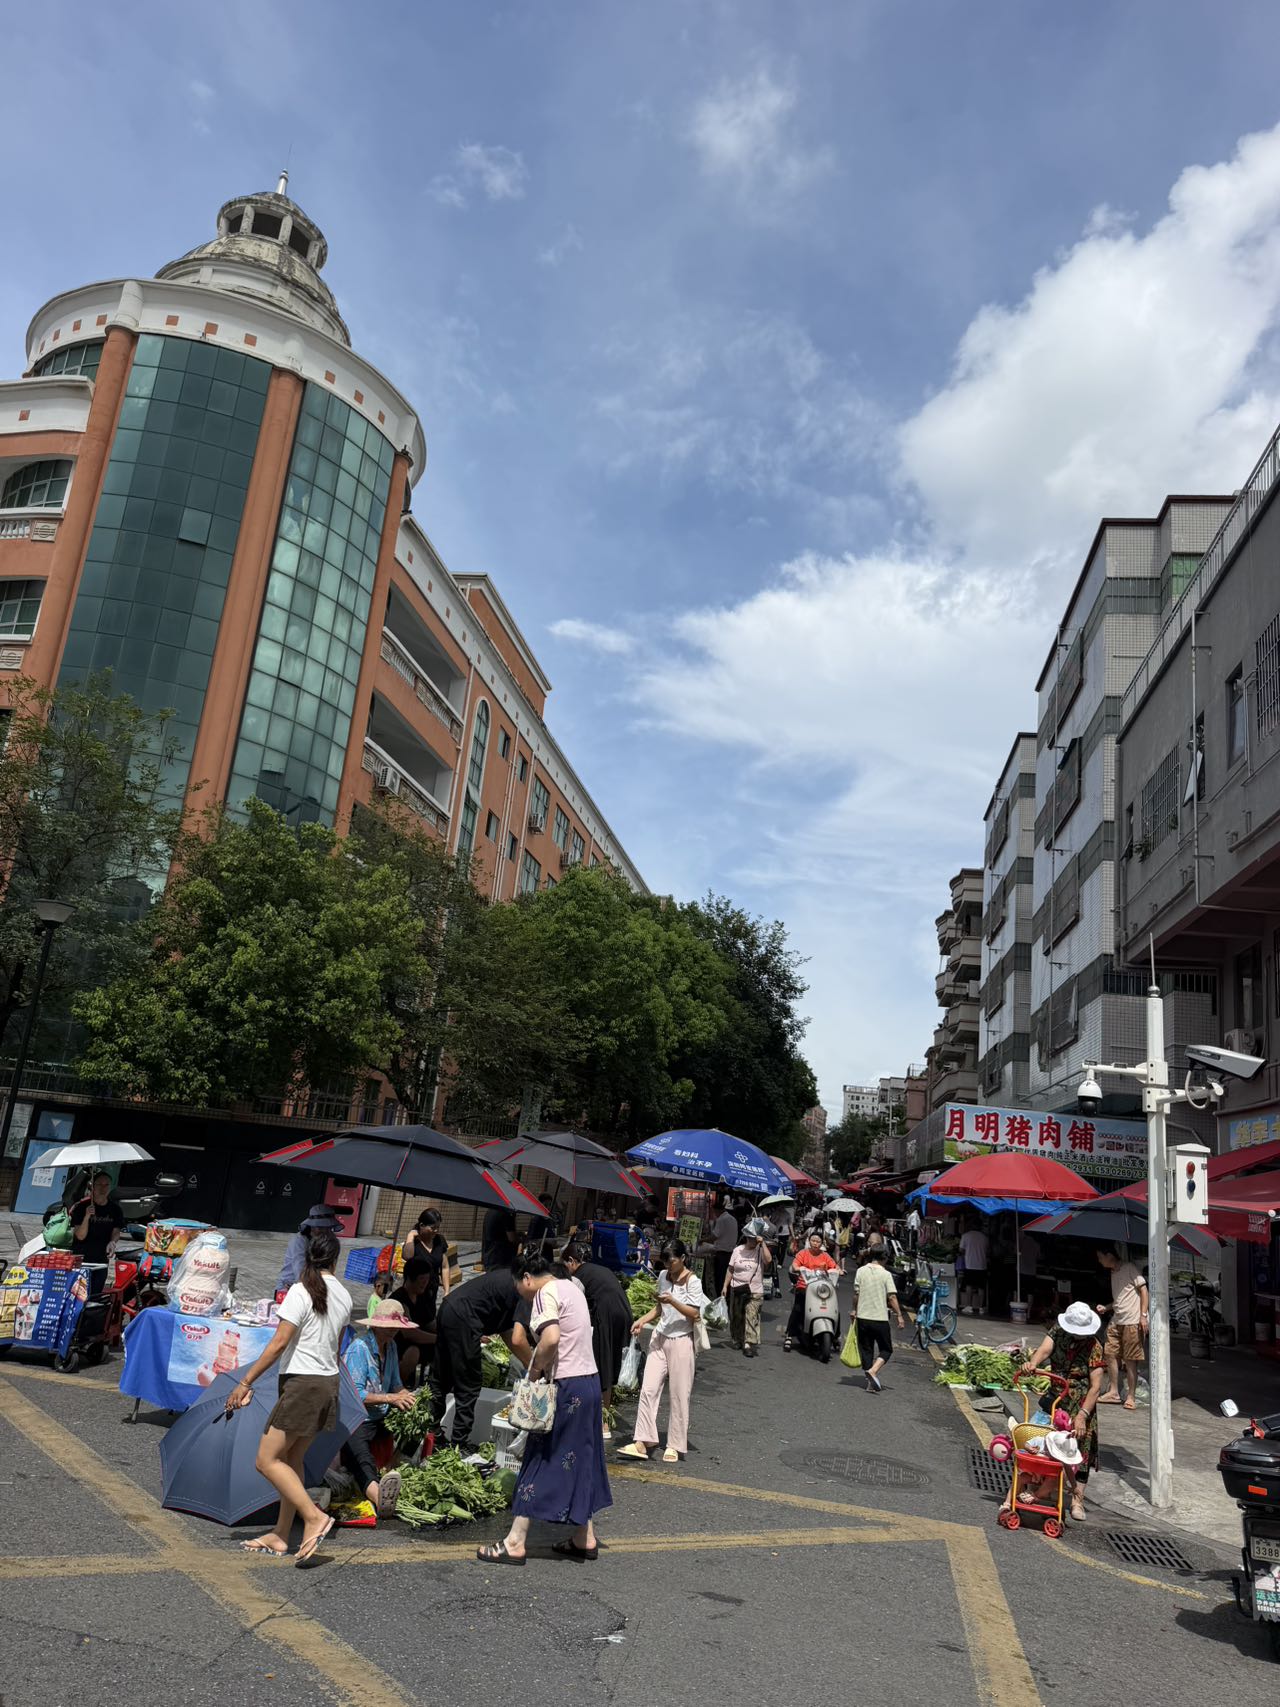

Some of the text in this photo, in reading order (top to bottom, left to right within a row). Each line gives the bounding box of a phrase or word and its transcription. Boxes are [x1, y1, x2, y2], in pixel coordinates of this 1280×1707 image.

[946, 1109, 1096, 1153] 月明猪肉铺
[193, 1258, 220, 1270] Yakult
[185, 1294, 211, 1306] Yakult
[186, 1325, 206, 1334] Yakult
